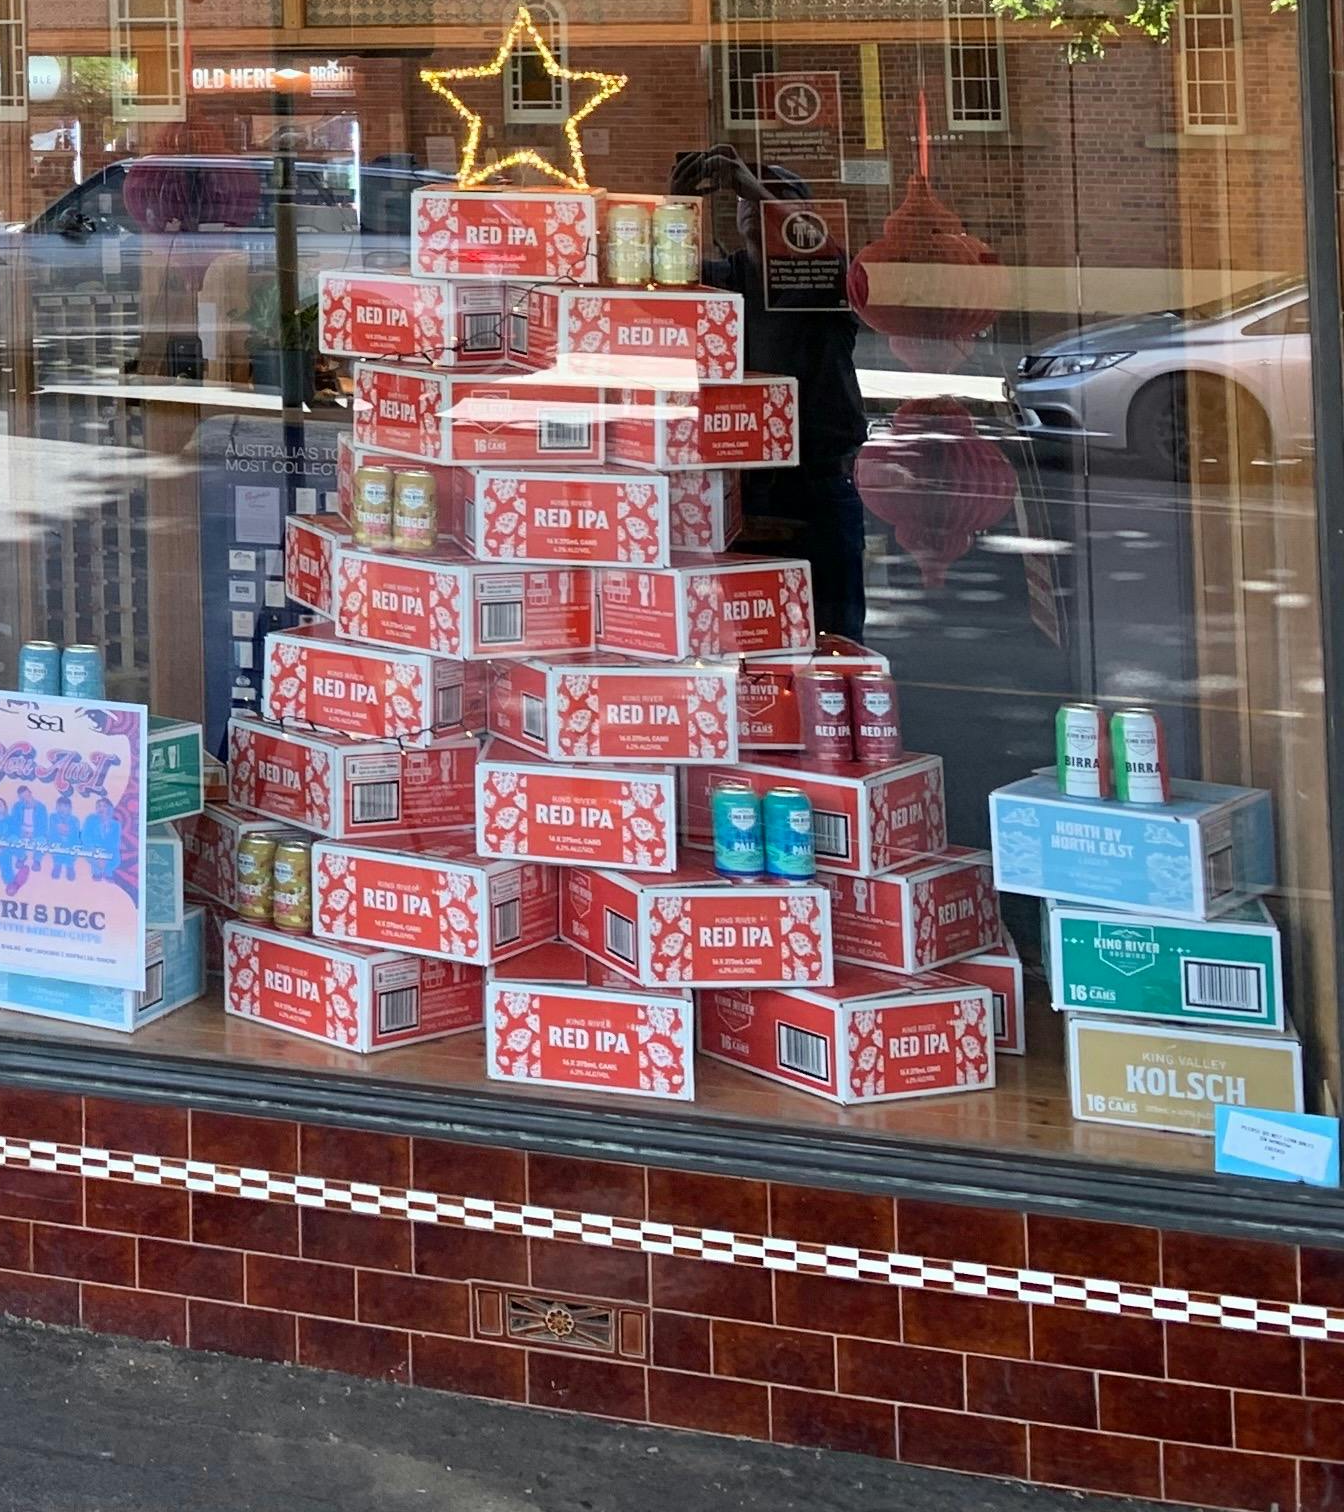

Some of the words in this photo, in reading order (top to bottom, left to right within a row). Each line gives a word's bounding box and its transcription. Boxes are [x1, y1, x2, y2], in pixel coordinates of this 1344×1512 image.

[230, 68, 276, 89] HERE
[466, 226, 506, 244] RED
[508, 226, 538, 247] IPA
[356, 306, 382, 325] RED
[386, 308, 409, 327] IPA
[617, 326, 653, 346] RED
[660, 327, 689, 346] IPA
[704, 413, 731, 433] RED
[735, 412, 758, 431] IPA
[224, 443, 319, 460] AUSTRALIA'S
[474, 439, 486, 453] 16
[487, 440, 506, 451] CANS
[226, 459, 266, 473] MOST
[534, 507, 572, 528] RED
[577, 509, 610, 530] IPA
[372, 589, 399, 612] RED
[402, 593, 425, 617] IPA
[723, 601, 750, 621] RED
[753, 599, 776, 619] IPA
[313, 676, 346, 699] RED
[350, 681, 379, 705] IPA
[753, 685, 779, 696] RIVER
[607, 704, 646, 725] RED
[649, 705, 681, 726] IPA
[751, 723, 773, 734] CANS
[815, 724, 840, 737] RED
[860, 724, 881, 737] RED
[883, 725, 898, 737] IPA
[1064, 755, 1101, 769] BIRRA
[1125, 761, 1161, 773] BIRRA
[258, 760, 280, 782] RED
[282, 766, 302, 791] IPA
[535, 803, 574, 826] RED
[580, 806, 615, 830] IPA
[1056, 820, 1100, 839] NORTH
[1103, 826, 1122, 843] BY
[1051, 834, 1096, 854] NORTH
[1100, 842, 1134, 858] EAST
[363, 887, 398, 912] RED
[402, 893, 432, 919] IPA
[33, 904, 48, 923] 8
[54, 906, 106, 930] DEC
[699, 926, 738, 948] RED
[741, 926, 773, 948] IPA
[1094, 937, 1122, 951] KING
[1124, 940, 1160, 954] RIVER
[264, 969, 292, 993] RED
[295, 976, 321, 1004] IPA
[1069, 984, 1087, 1001] 16
[1089, 987, 1116, 1001] CANS
[731, 998, 755, 1016] RIVER
[548, 1025, 589, 1050] RED
[595, 1030, 631, 1055] IPA
[889, 1035, 921, 1059] RED
[924, 1032, 950, 1055] IPA
[1142, 1052, 1174, 1066] KING
[1178, 1056, 1227, 1070] VALLEY
[1125, 1064, 1247, 1106] KOLSCH
[1086, 1094, 1105, 1112] 16
[1108, 1098, 1138, 1113] CANS
